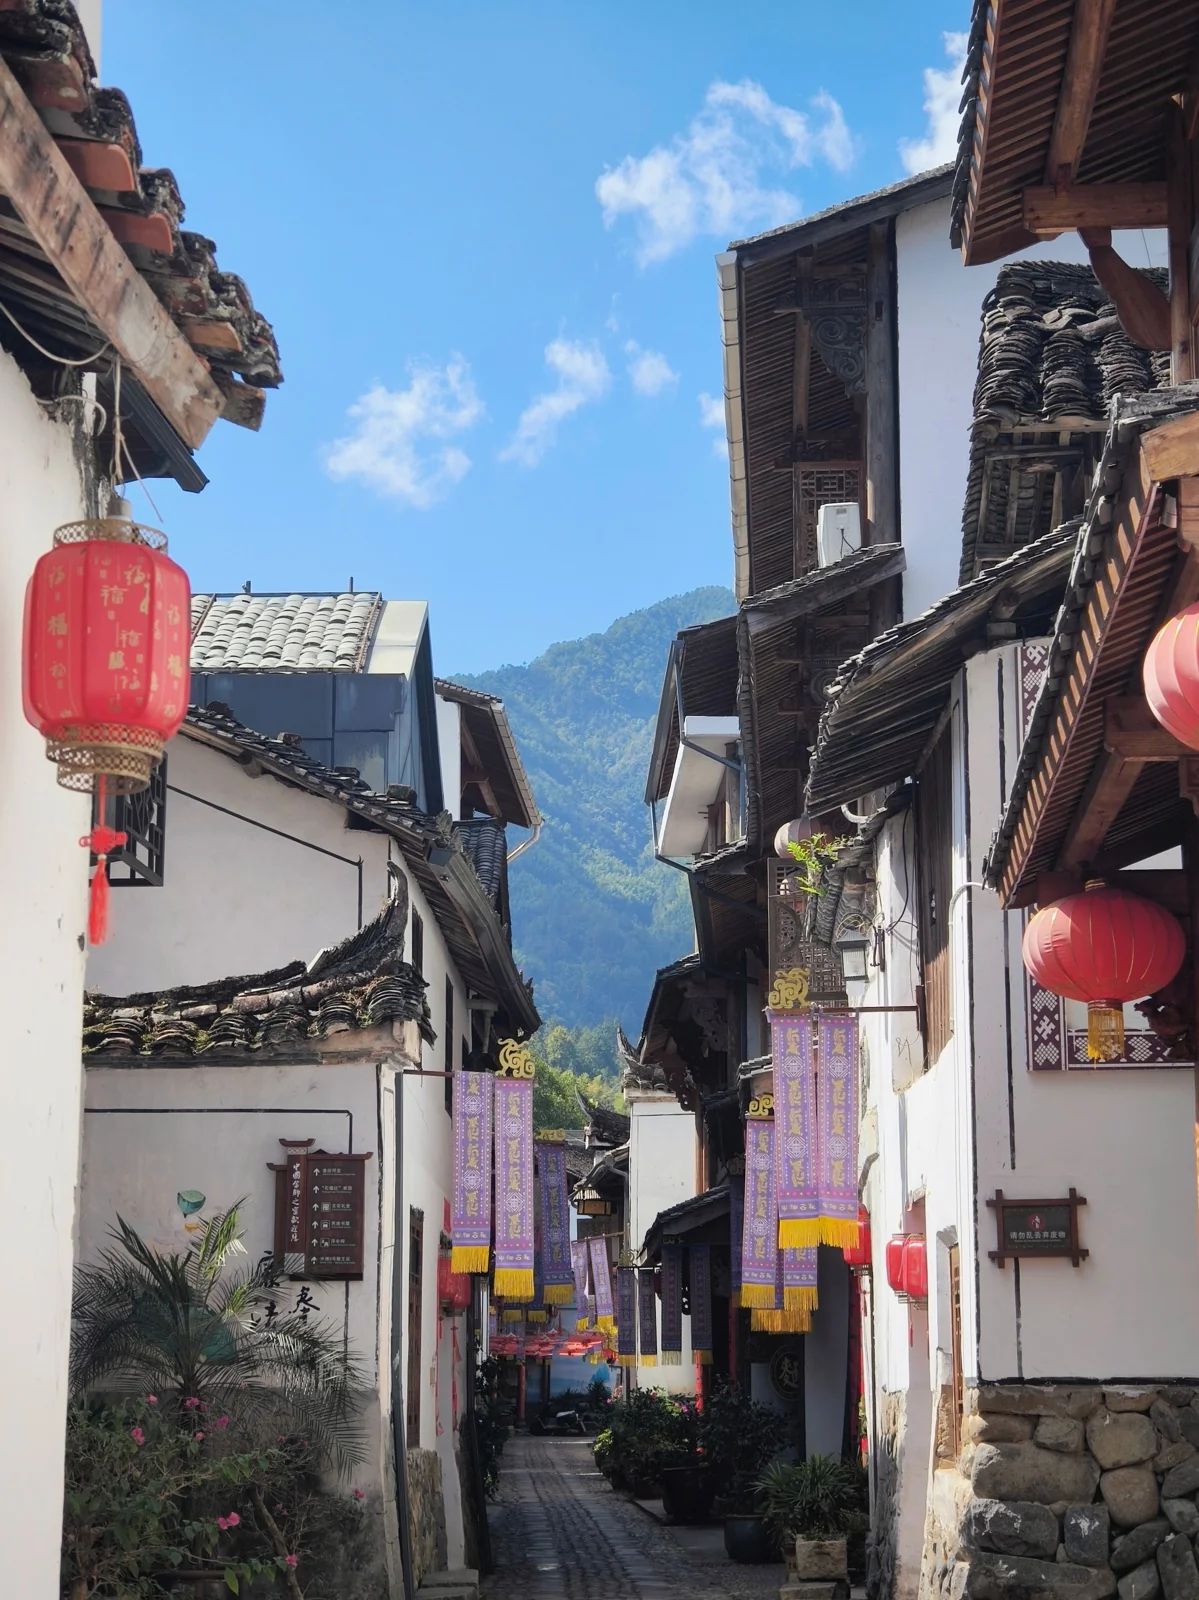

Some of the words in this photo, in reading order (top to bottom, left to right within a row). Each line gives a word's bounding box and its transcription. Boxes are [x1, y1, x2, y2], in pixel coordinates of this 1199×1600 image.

[101, 585, 128, 606] 福
[47, 612, 68, 636] 福
[120, 630, 143, 648] 福
[1009, 1230, 1066, 1239] 请勿乱丢弃废物
